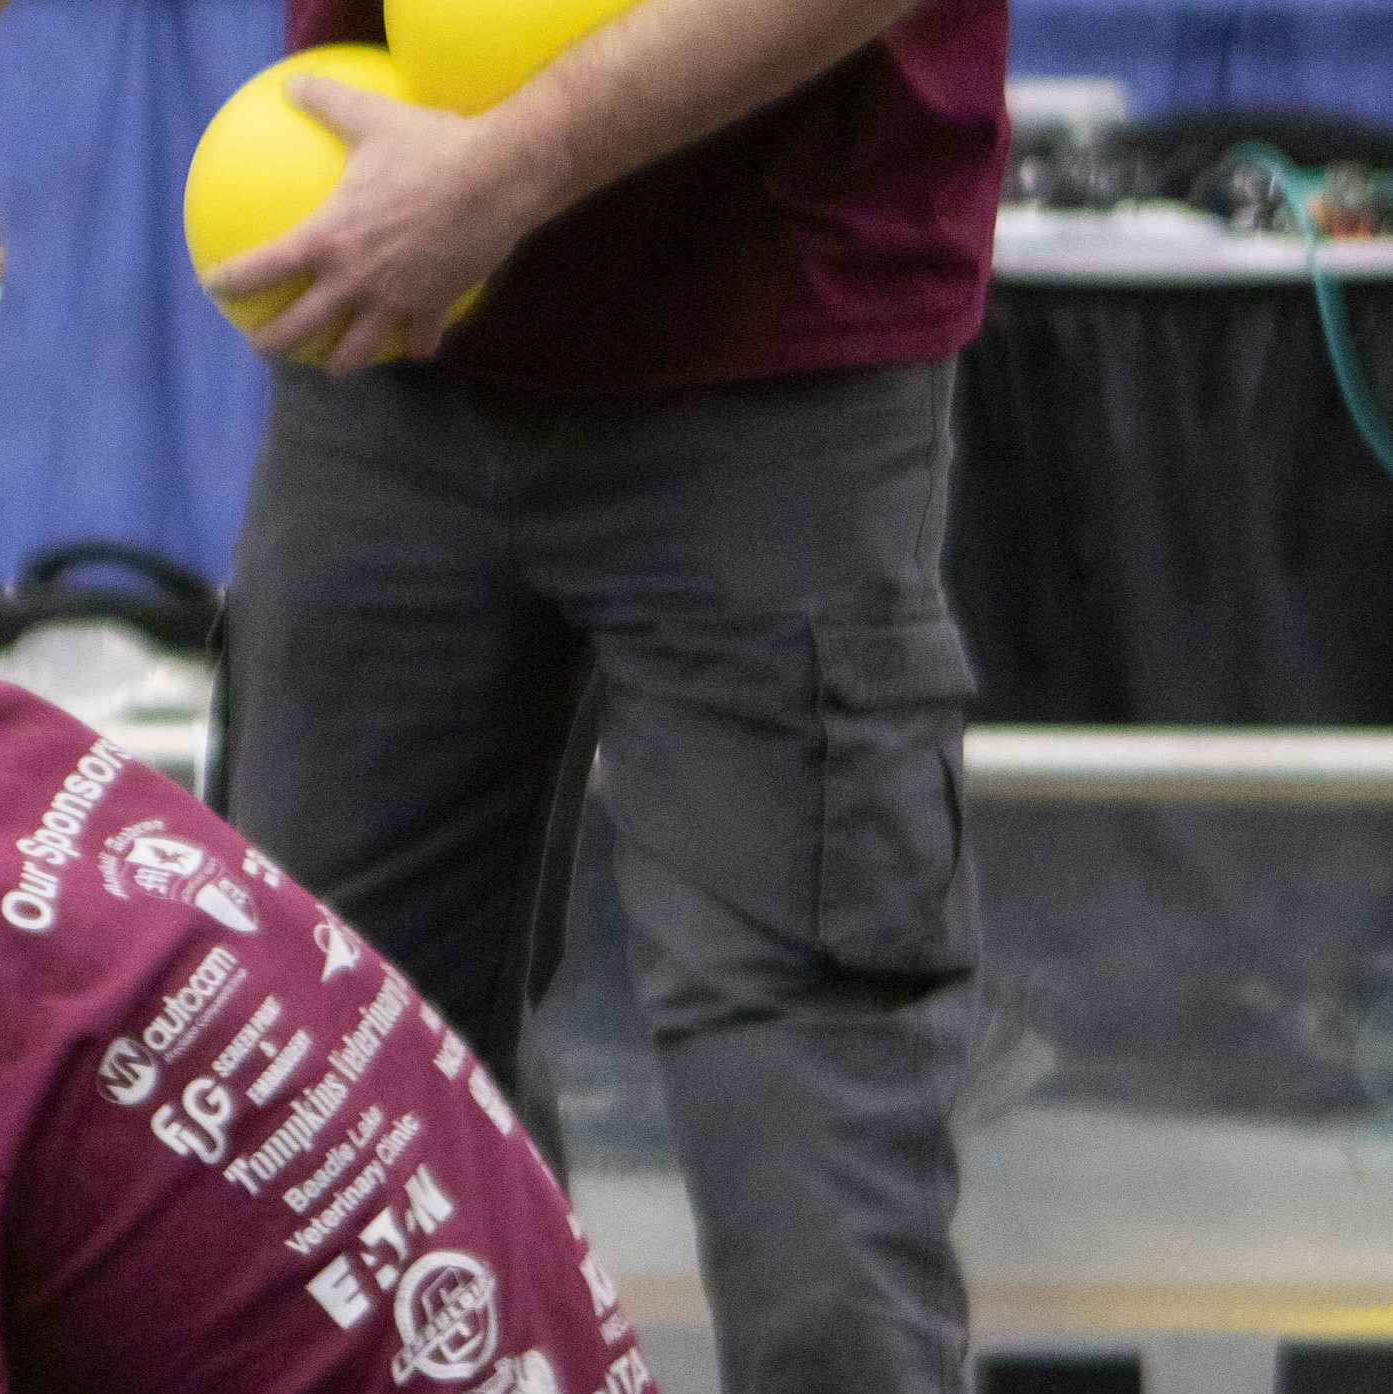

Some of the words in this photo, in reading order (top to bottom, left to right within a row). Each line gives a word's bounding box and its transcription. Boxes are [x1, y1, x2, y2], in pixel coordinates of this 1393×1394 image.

[1, 860, 59, 932] Our
[142, 946, 239, 1051] autocam
[283, 1159, 387, 1254] Veterinary
